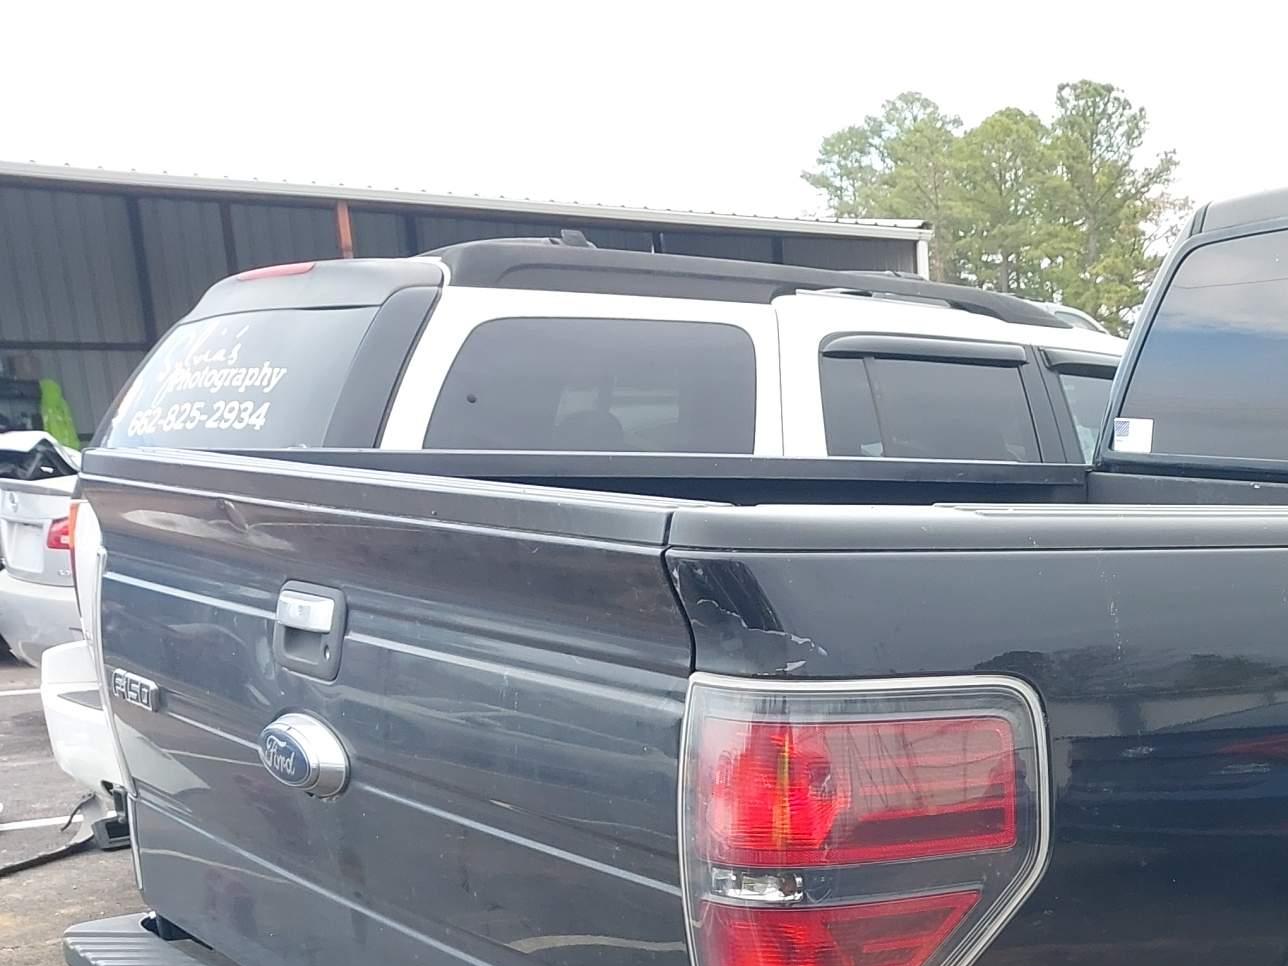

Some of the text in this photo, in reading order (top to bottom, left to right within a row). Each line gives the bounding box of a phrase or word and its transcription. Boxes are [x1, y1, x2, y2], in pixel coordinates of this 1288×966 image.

[166, 360, 287, 394] Photography
[128, 400, 271, 437] 662-825-2934
[264, 735, 296, 776] Ford
